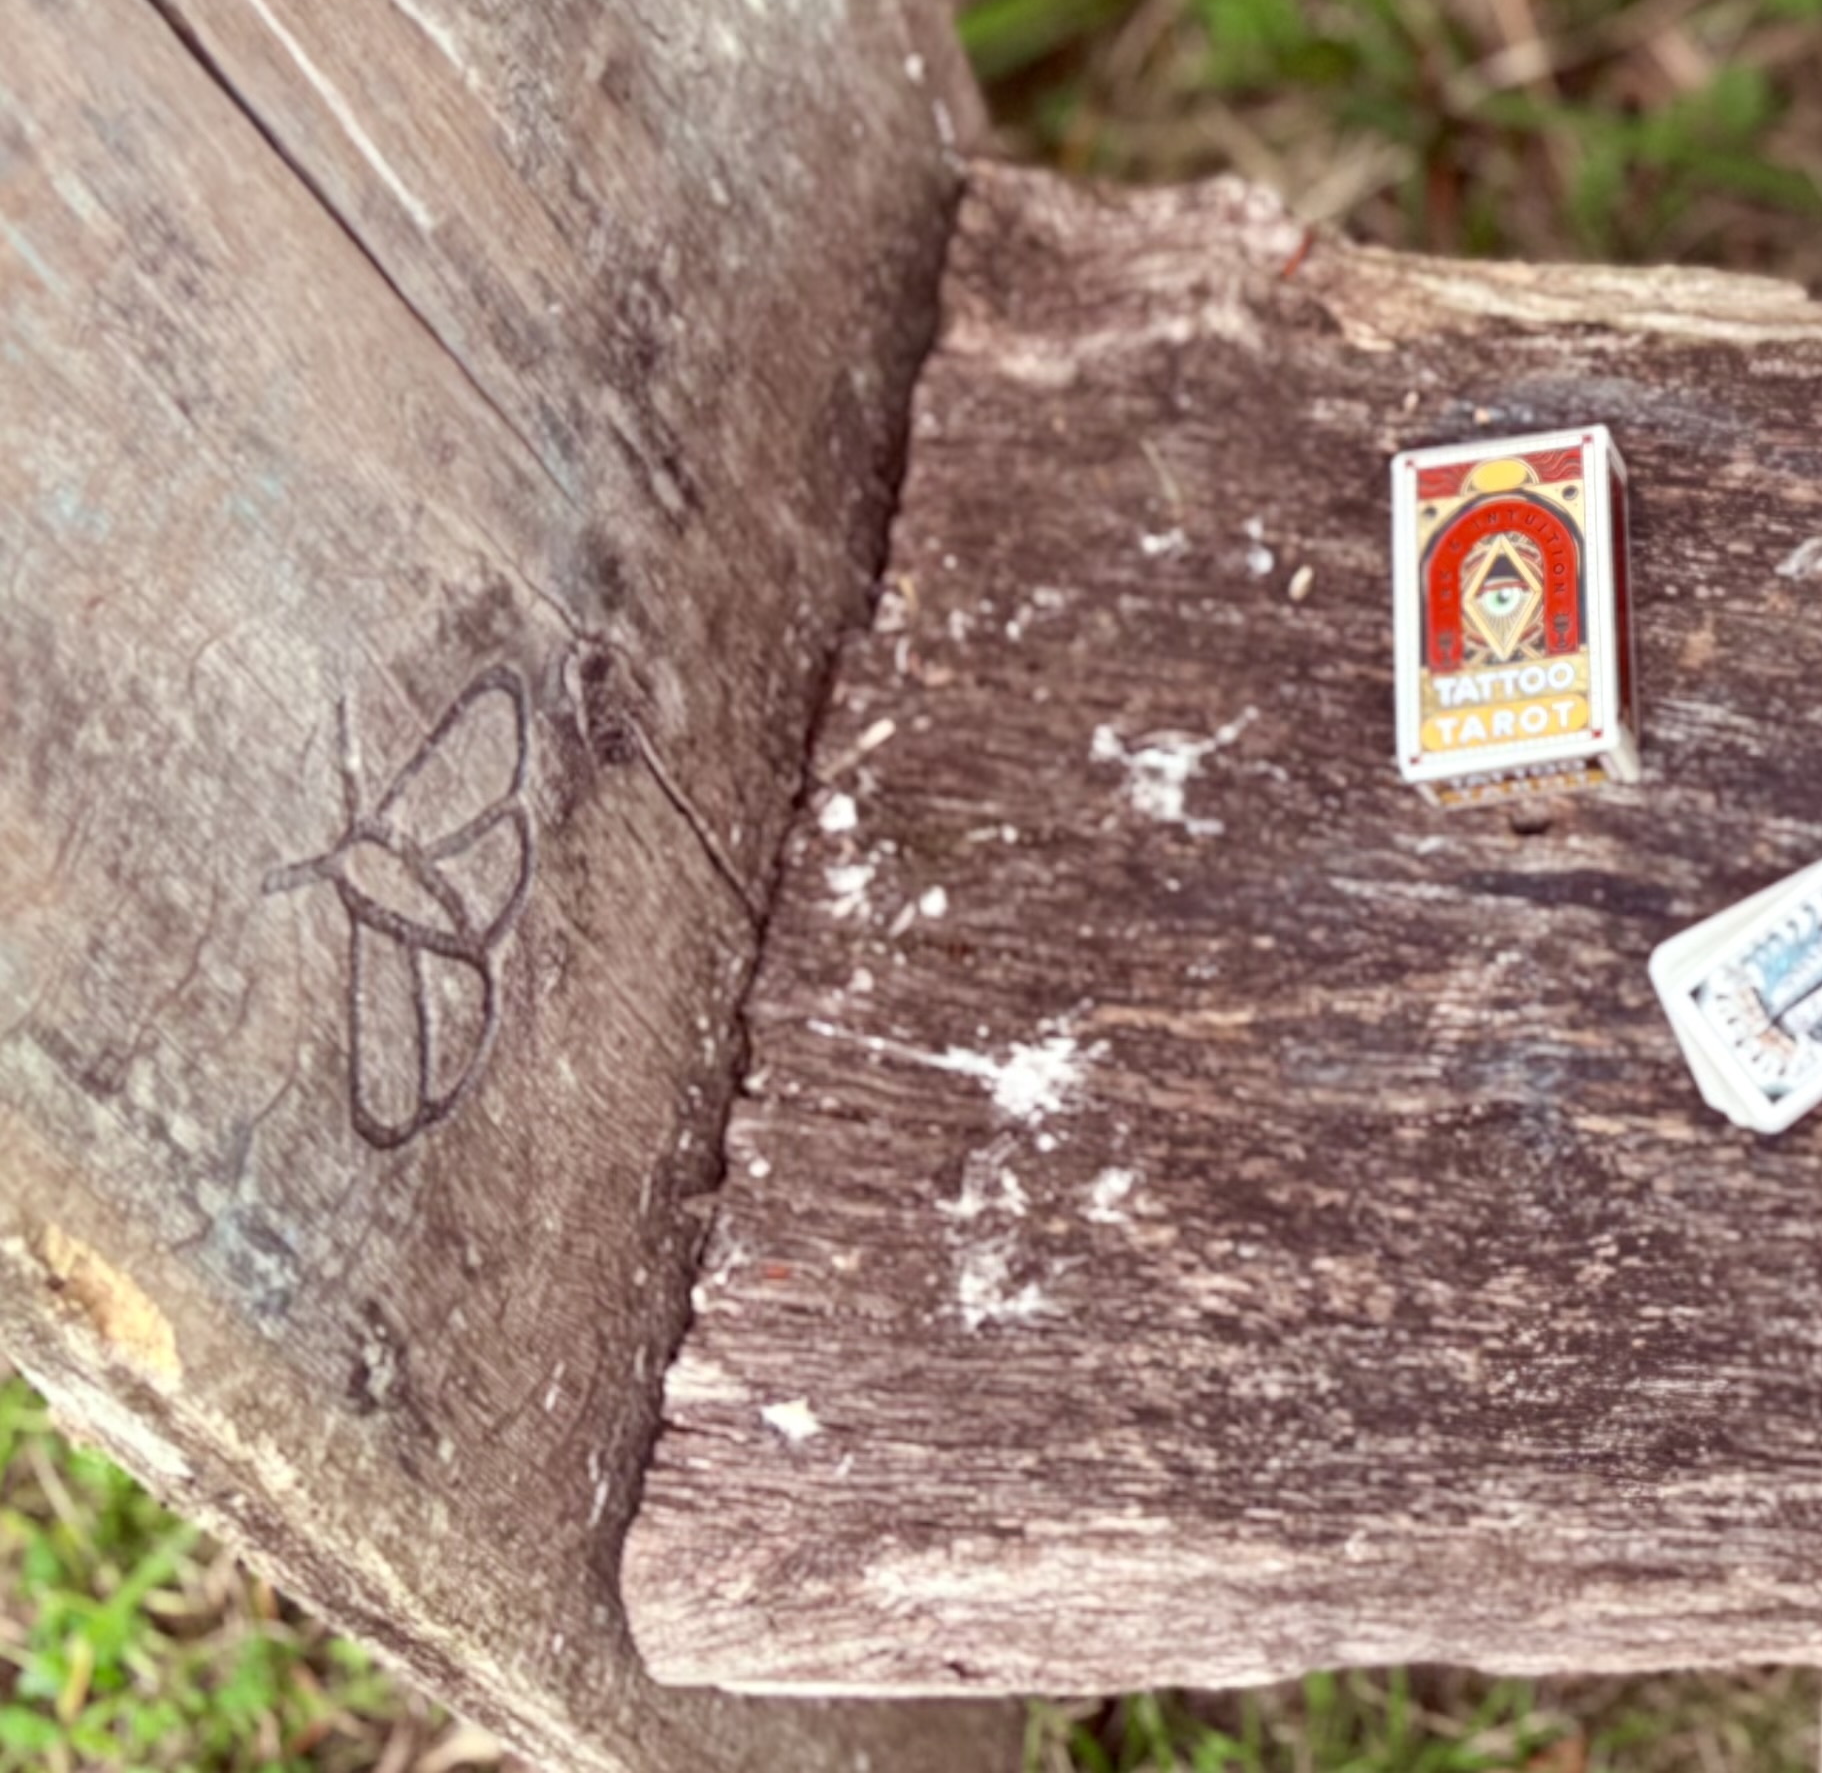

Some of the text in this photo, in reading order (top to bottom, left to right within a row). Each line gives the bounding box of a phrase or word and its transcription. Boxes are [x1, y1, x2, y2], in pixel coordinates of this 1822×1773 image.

[1474, 509, 1566, 593] INTUITION
[1433, 661, 1575, 707] TATTOO
[1434, 700, 1575, 745] TAROT
